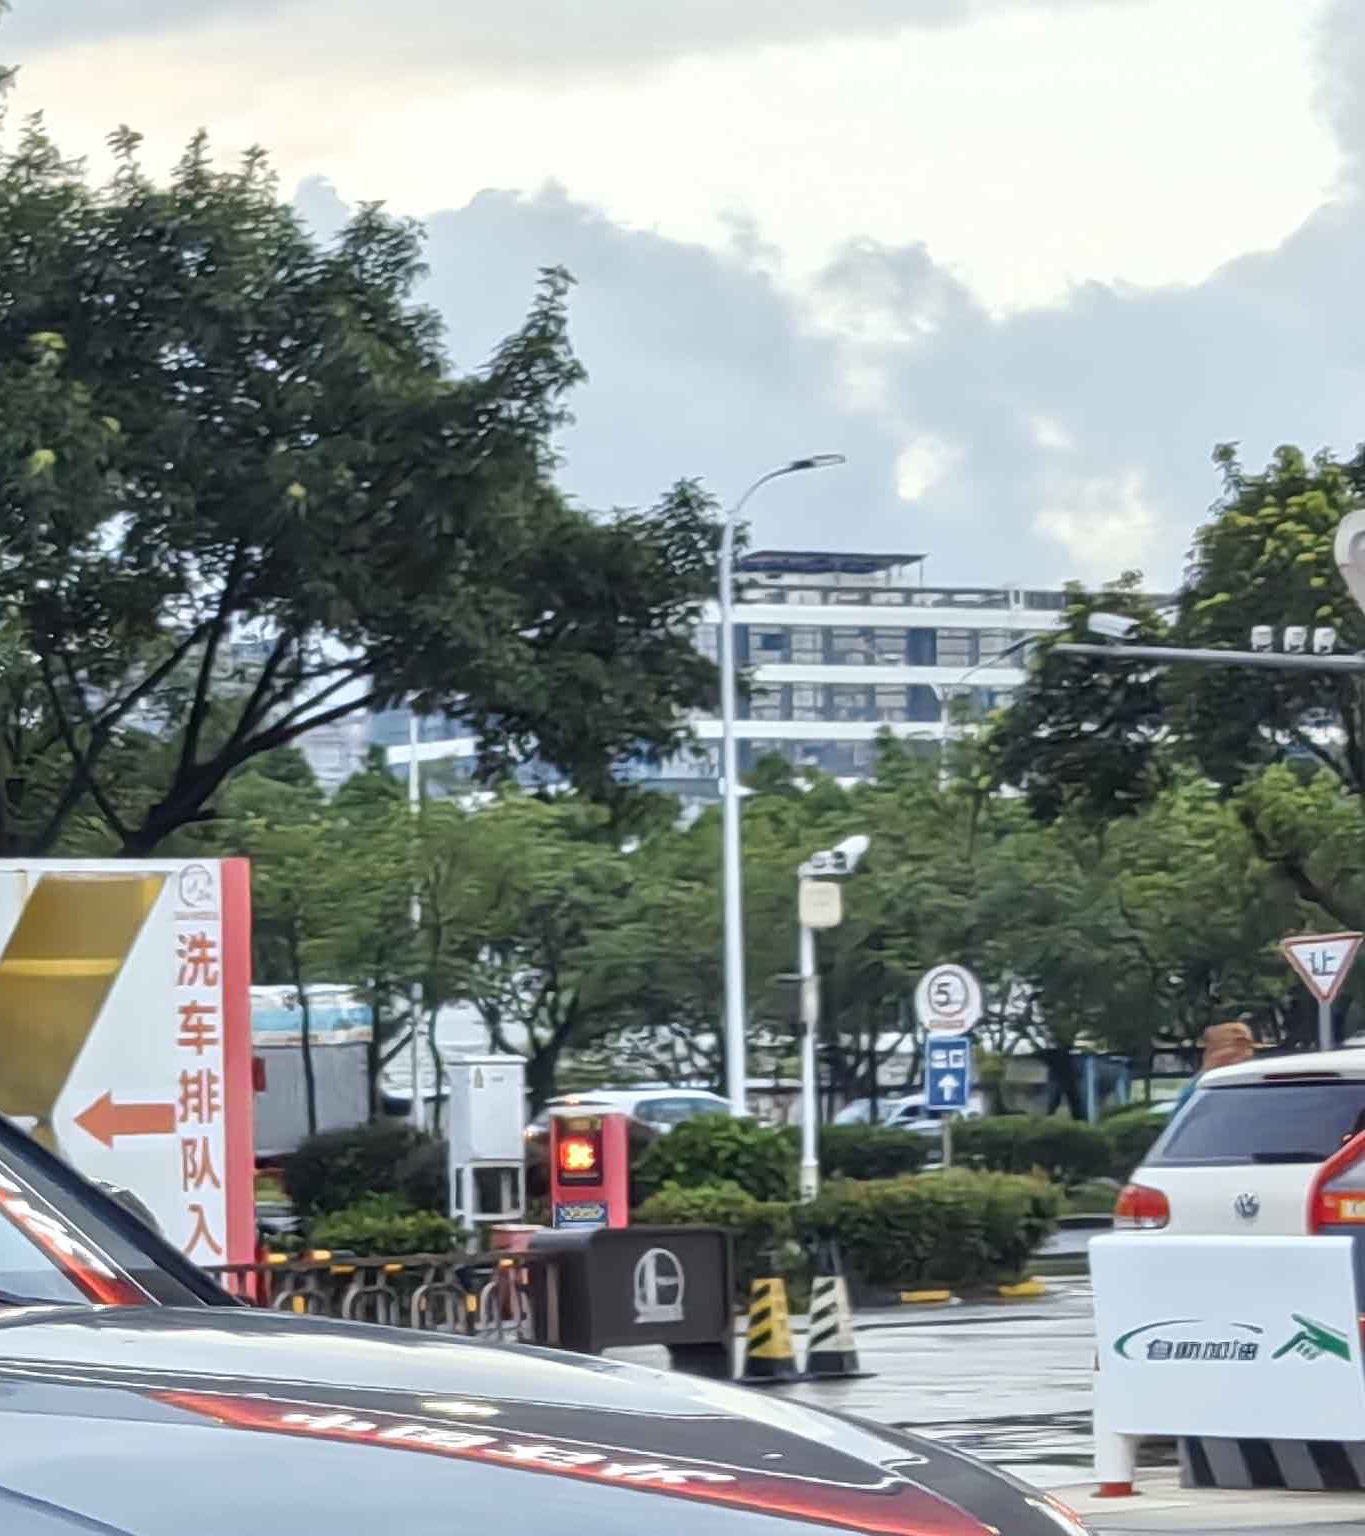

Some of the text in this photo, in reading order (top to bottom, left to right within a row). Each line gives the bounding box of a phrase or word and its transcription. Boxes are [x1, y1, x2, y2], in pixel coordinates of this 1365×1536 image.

[1308, 950, 1342, 976] 让
[935, 982, 950, 1007] 5
[176, 930, 222, 1257] 洗车排队入
[1146, 1338, 1260, 1361] 自助加油
